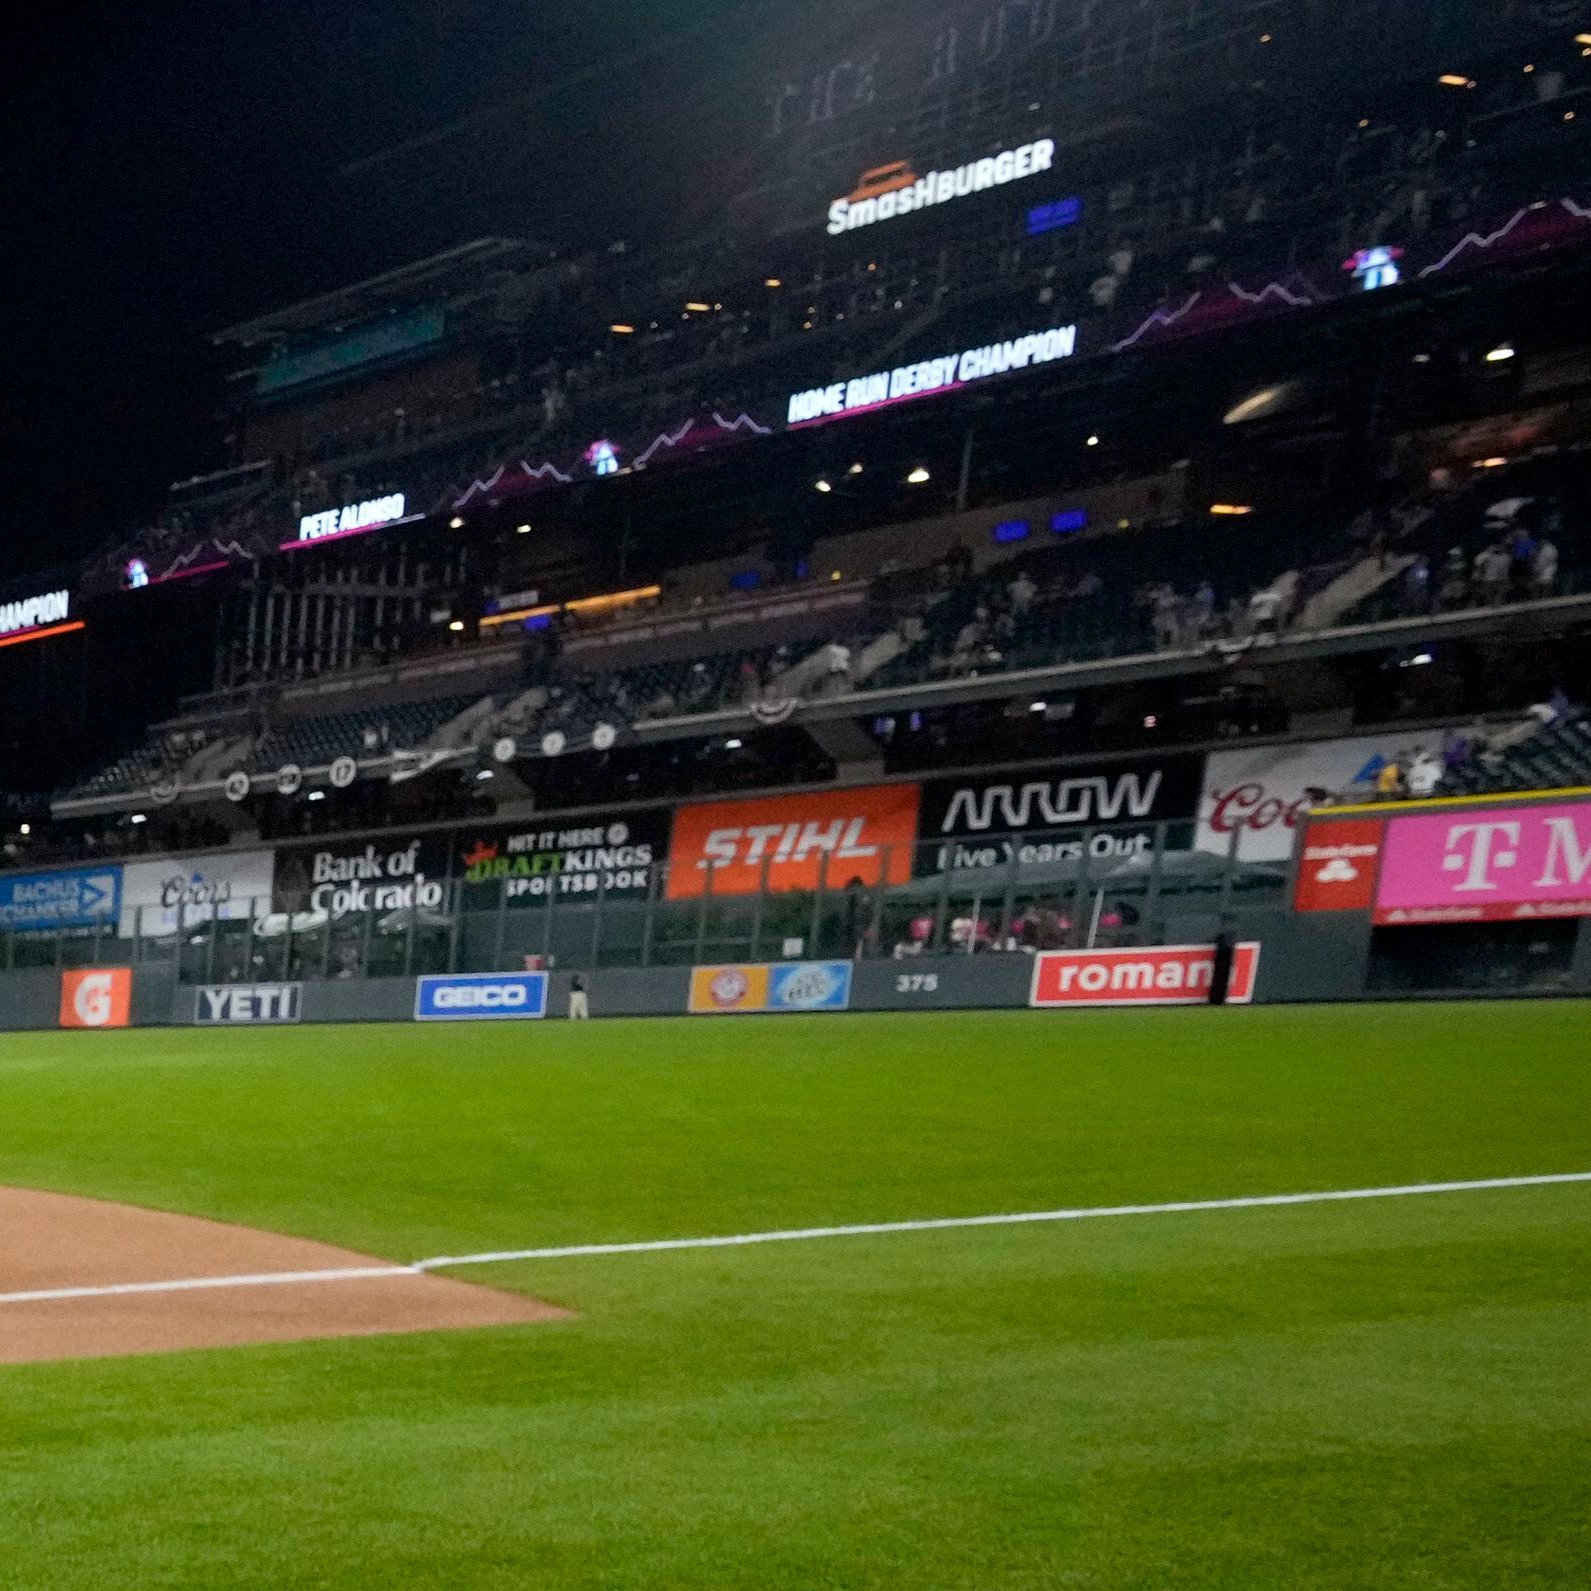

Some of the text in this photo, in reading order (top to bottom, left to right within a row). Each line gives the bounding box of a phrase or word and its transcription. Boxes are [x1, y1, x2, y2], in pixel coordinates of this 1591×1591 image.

[787, 324, 1076, 424] HOME RUN DERBY CHAMPION
[299, 493, 405, 540] PETE ALONSO
[312, 840, 420, 883] Bank of
[698, 817, 877, 870] STIHL
[1089, 833, 1151, 858] Out
[74, 974, 113, 1025] G
[204, 988, 290, 1020] YETI
[432, 984, 527, 1008] GEICO
